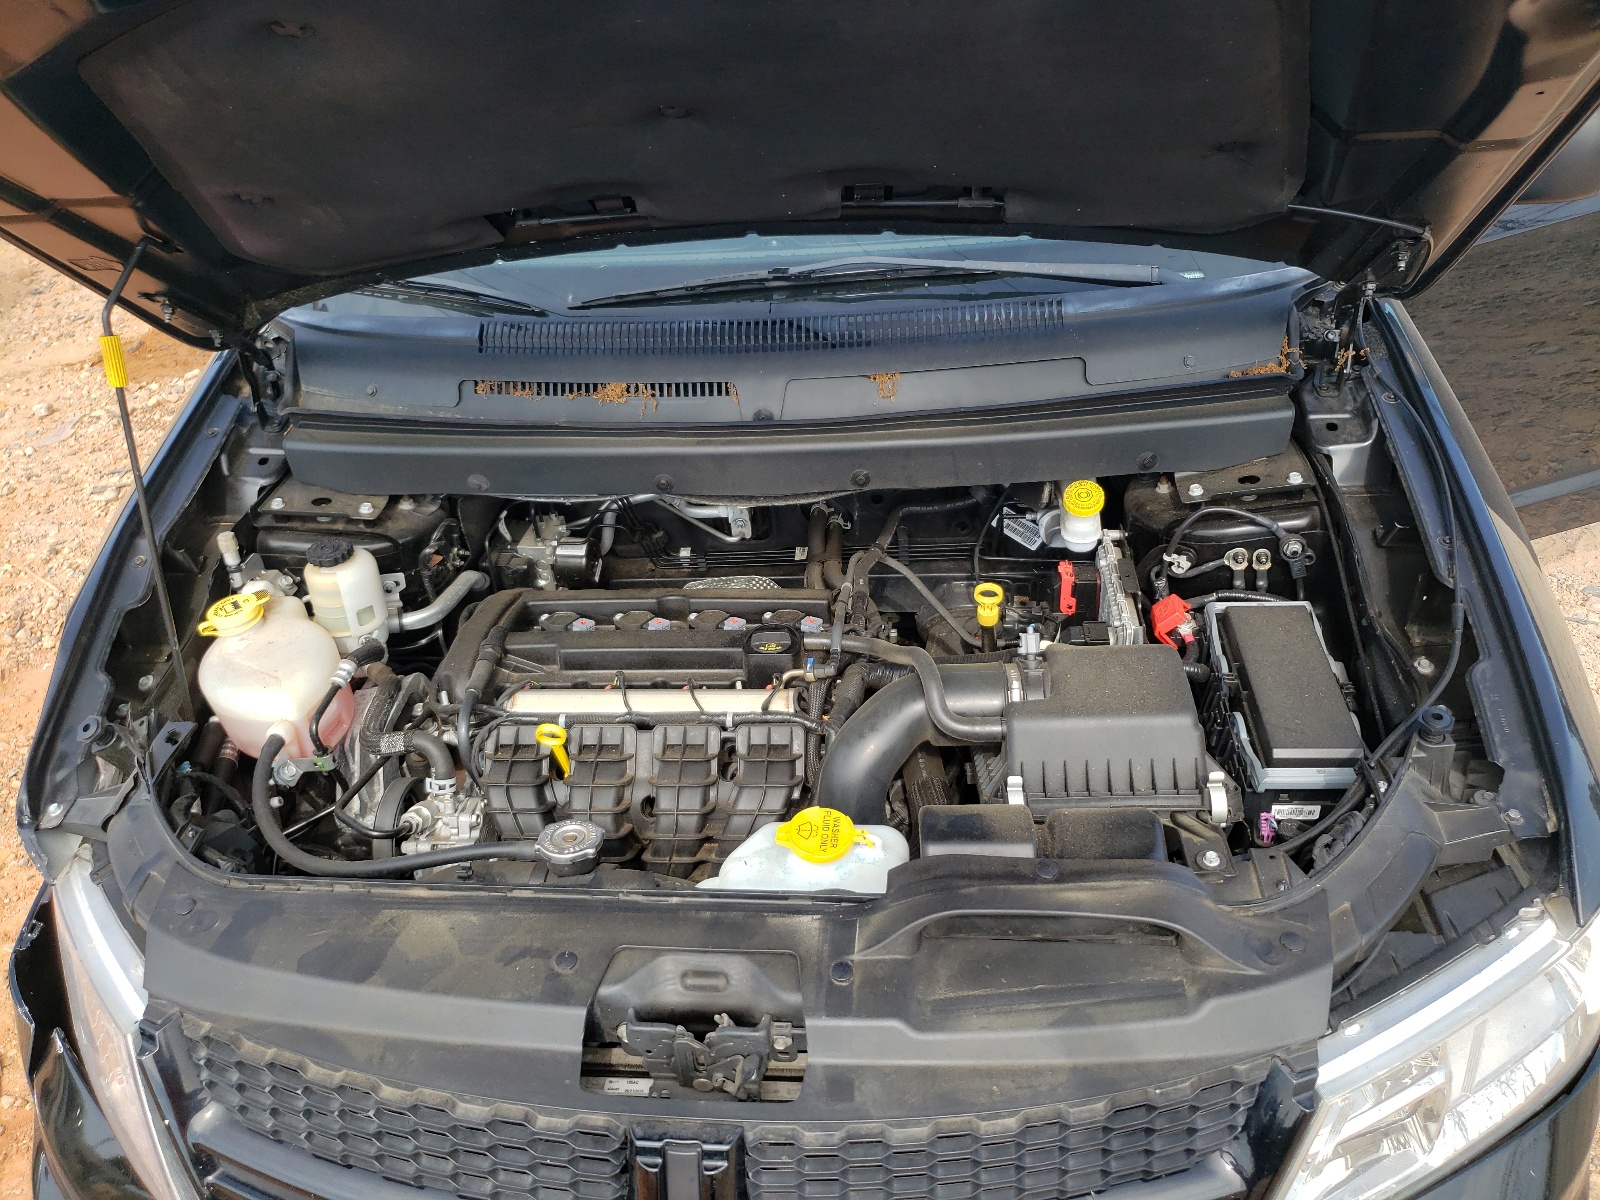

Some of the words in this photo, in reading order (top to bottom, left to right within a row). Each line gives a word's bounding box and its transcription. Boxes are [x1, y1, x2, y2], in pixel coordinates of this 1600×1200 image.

[822, 810, 832, 832] FLUID
[819, 833, 829, 853] ONLY
[830, 816, 841, 849] WASHER
